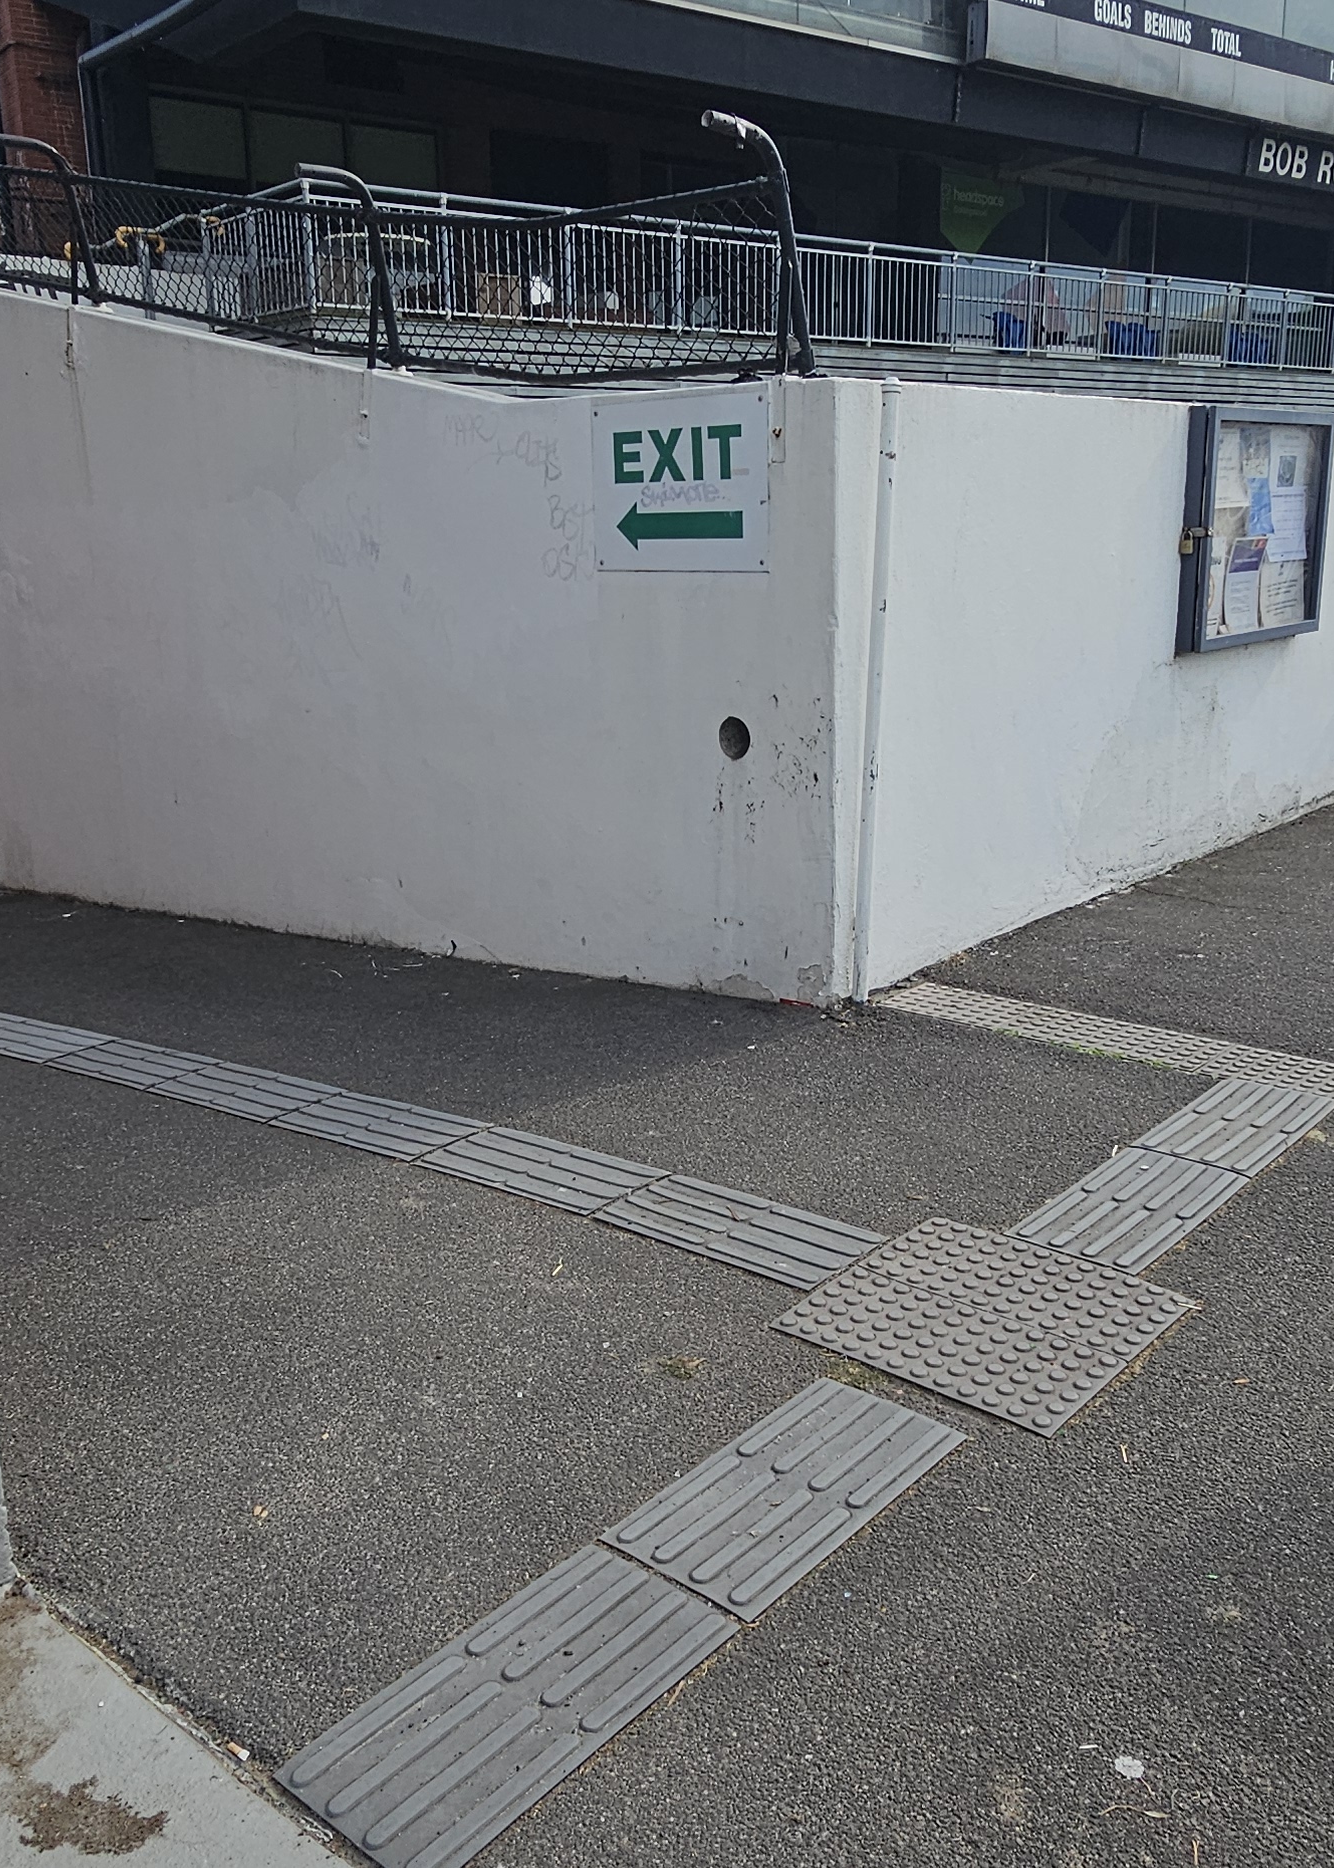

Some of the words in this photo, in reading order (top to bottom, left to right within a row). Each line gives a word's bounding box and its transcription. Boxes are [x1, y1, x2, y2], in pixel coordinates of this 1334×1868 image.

[1094, 0, 1132, 29] GOALS
[1144, 9, 1192, 45] BEHINDS
[1211, 27, 1242, 57] TOTAL
[1258, 138, 1309, 180] BOB
[612, 424, 742, 485] EXIT
